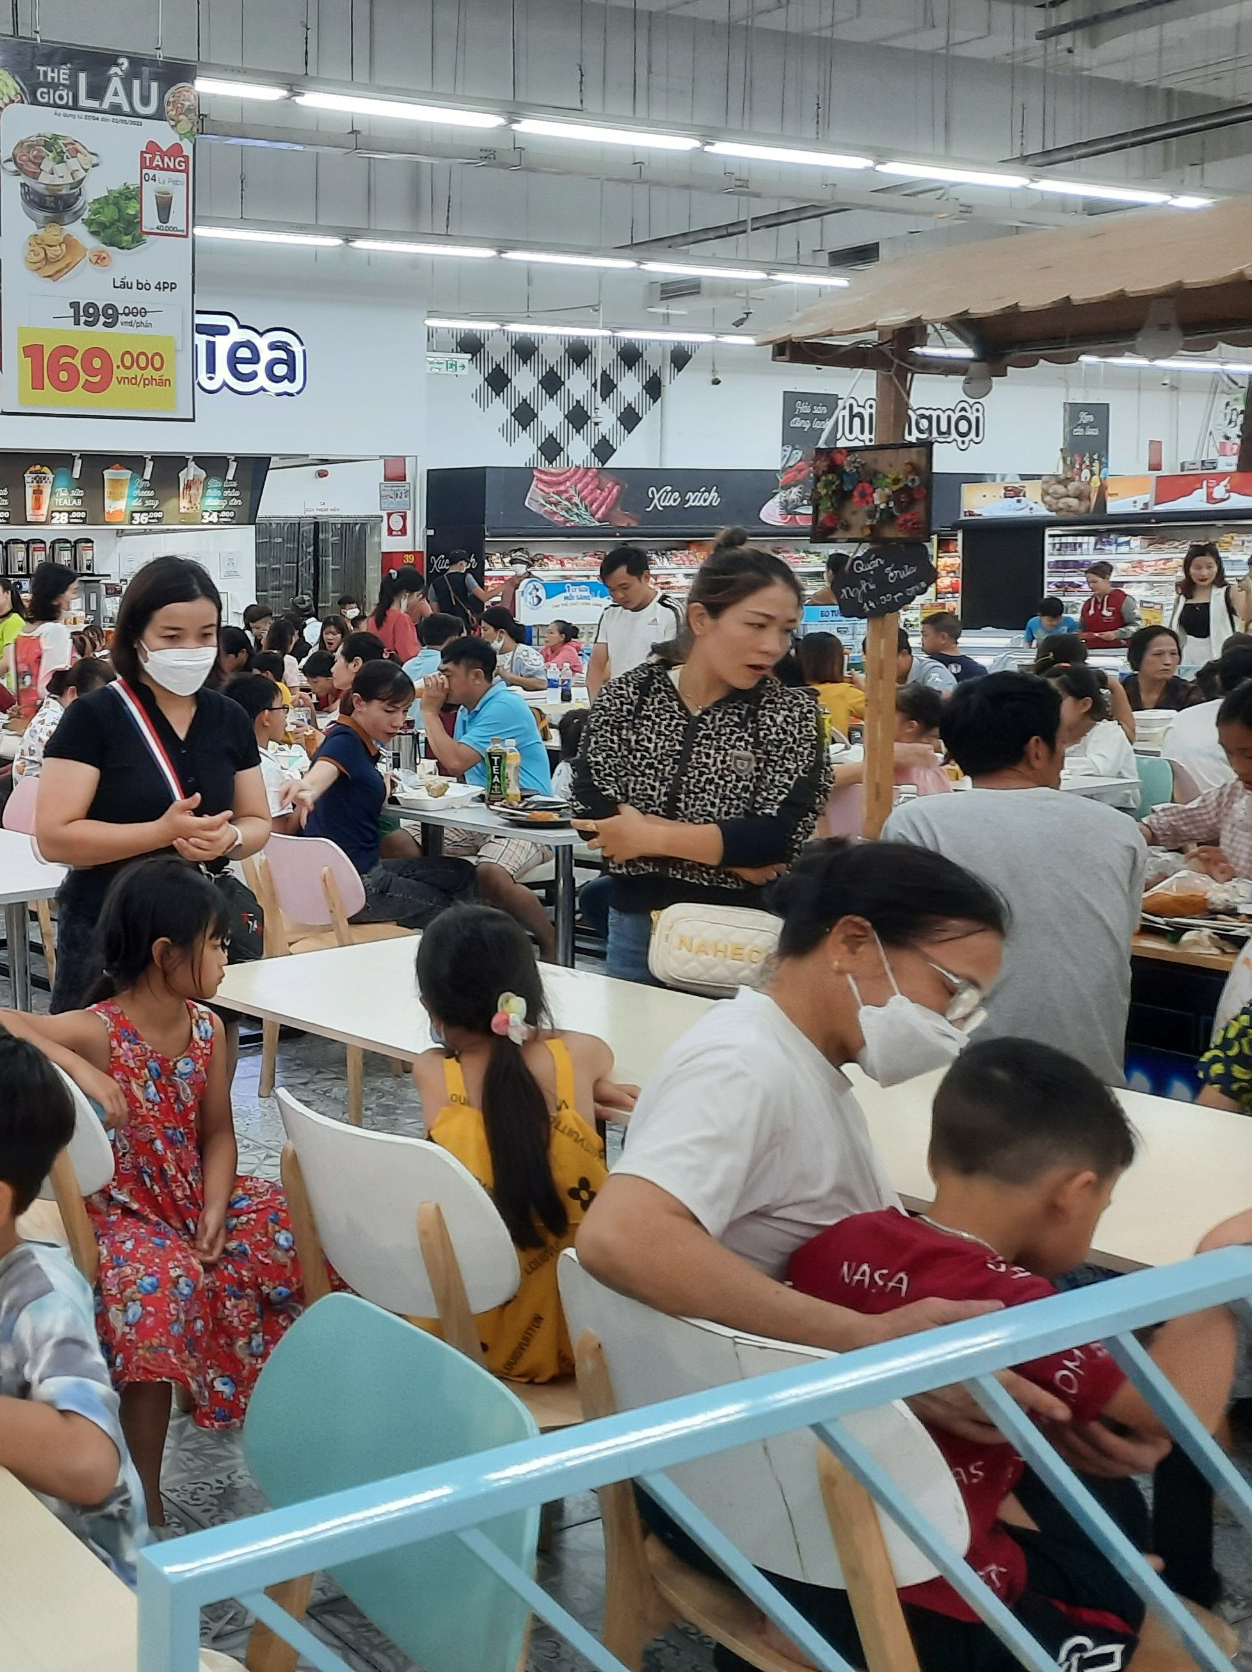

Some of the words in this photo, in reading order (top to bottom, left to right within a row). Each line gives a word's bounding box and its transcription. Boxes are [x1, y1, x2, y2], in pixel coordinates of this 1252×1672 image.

[36, 86, 73, 107] GIỚI
[77, 56, 159, 117] LẨU
[143, 152, 186, 170] TẶNG
[143, 173, 157, 182] 04
[112, 276, 133, 290] Lẩu
[136, 279, 152, 291] bò
[154, 281, 177, 293] 4PP
[195, 319, 299, 387] Tea
[645, 486, 682, 511] Xúc
[683, 486, 721, 508] xích
